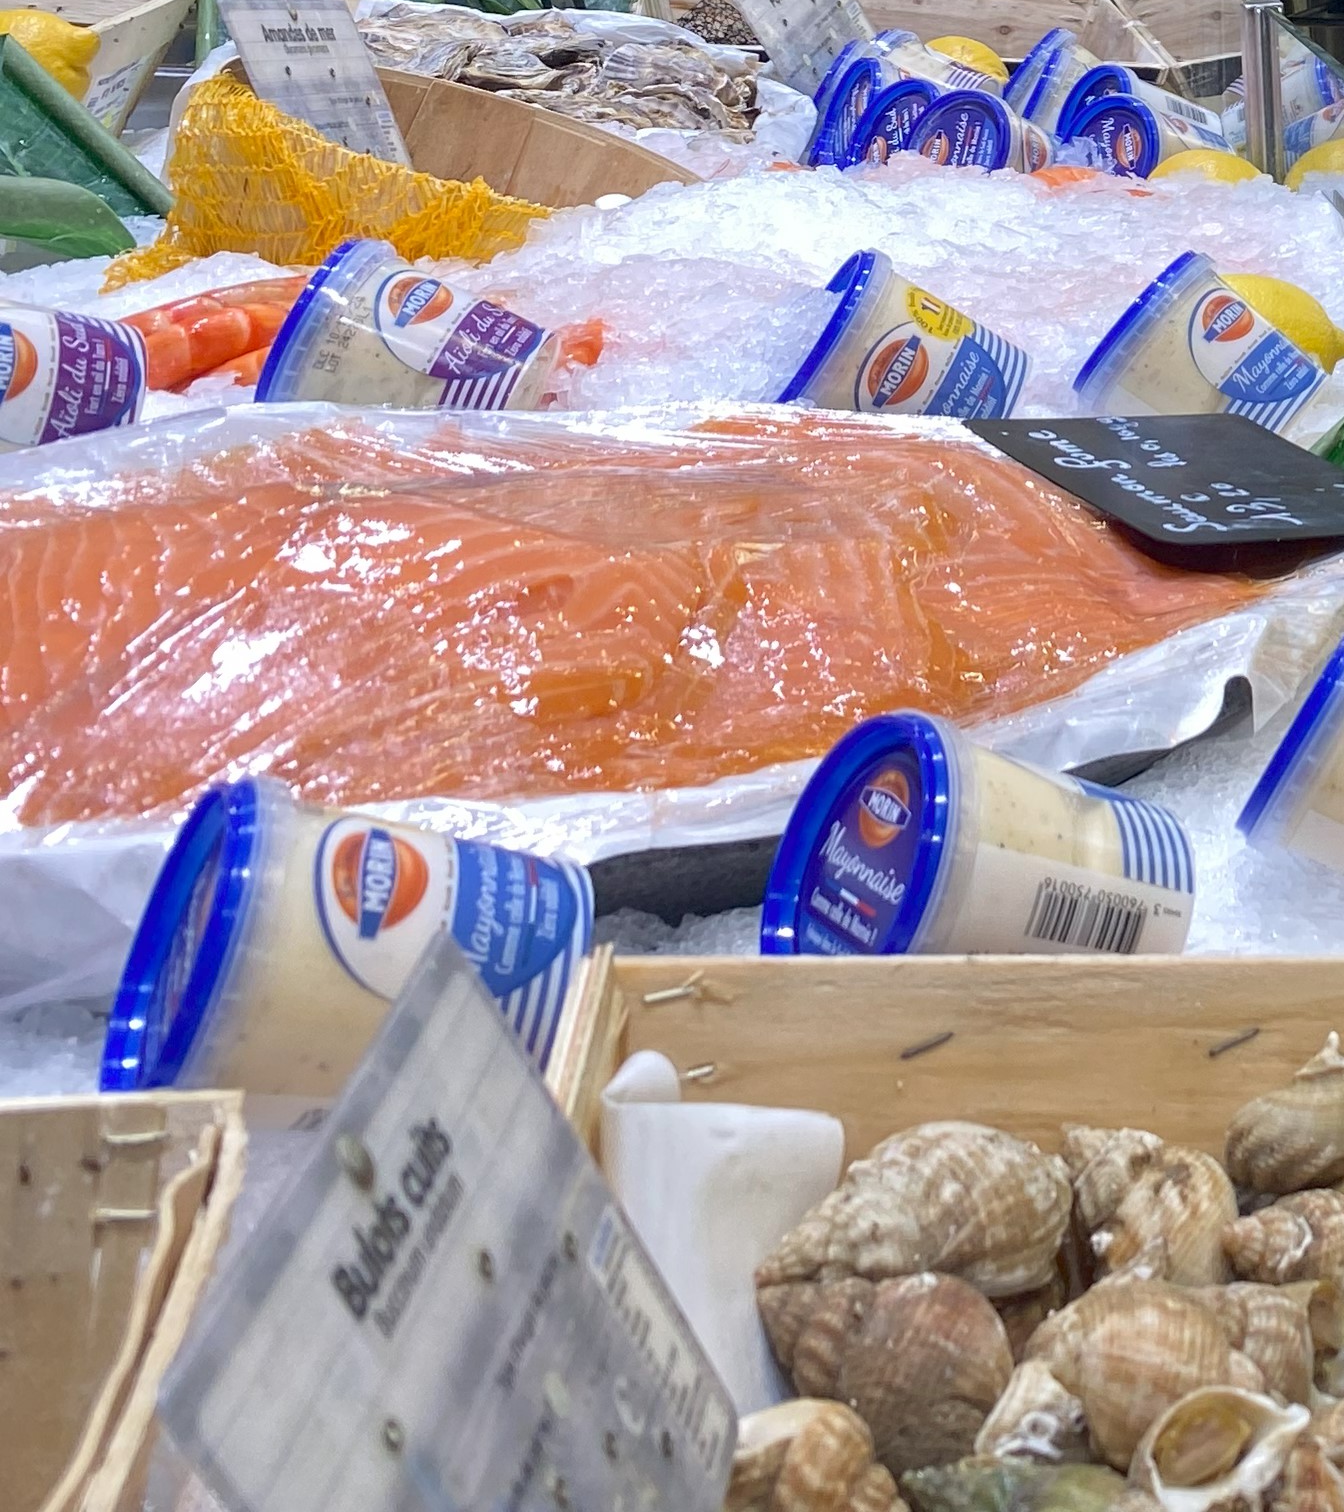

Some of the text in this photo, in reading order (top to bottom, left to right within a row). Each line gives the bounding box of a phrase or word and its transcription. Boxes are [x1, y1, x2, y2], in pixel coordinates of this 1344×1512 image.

[260, 23, 336, 42] Amandes de mer
[951, 112, 969, 168] onnaise
[1123, 133, 1135, 163] MORIN
[402, 276, 441, 325] MORIN
[1213, 299, 1245, 336] MORIN
[437, 307, 495, 375] Aïoli du
[48, 320, 94, 439] Aïoli du Sud
[879, 344, 917, 399] MORIN
[935, 349, 982, 415] onnaise
[1110, 473, 1229, 533] Saumon
[868, 788, 902, 823] MORIN
[364, 838, 394, 915] MORIN
[818, 819, 906, 906] Mayonnaise
[1042, 875, 1162, 916] 3 760050 750016
